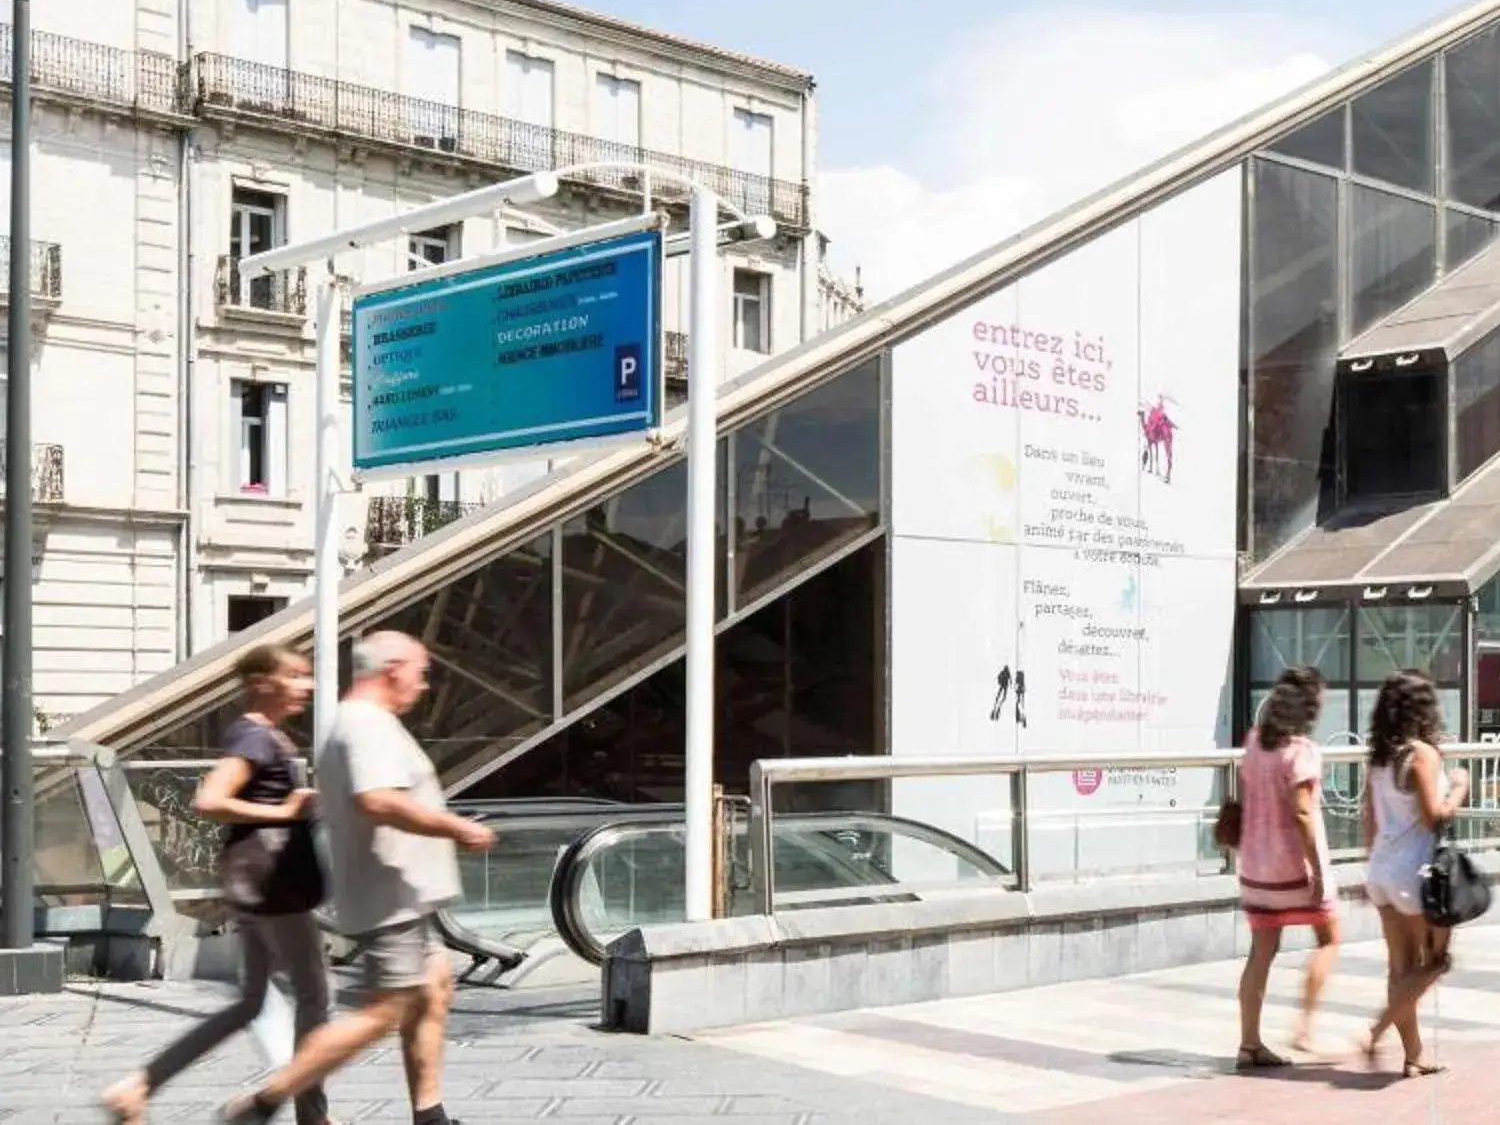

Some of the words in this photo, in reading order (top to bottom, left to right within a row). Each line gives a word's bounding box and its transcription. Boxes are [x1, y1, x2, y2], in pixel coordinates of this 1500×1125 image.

[497, 314, 589, 344] DECORATION
[973, 321, 1063, 357] entrez
[1073, 331, 1113, 368] ici,
[621, 356, 637, 386] P
[973, 351, 1041, 381] vous
[1052, 359, 1106, 393] êtes
[973, 378, 1103, 423] ailleurs...
[1024, 444, 1058, 459] Dans
[1062, 451, 1079, 465] un
[1051, 508, 1094, 524] proche
[1097, 511, 1113, 526] de
[1092, 529, 1114, 544] des
